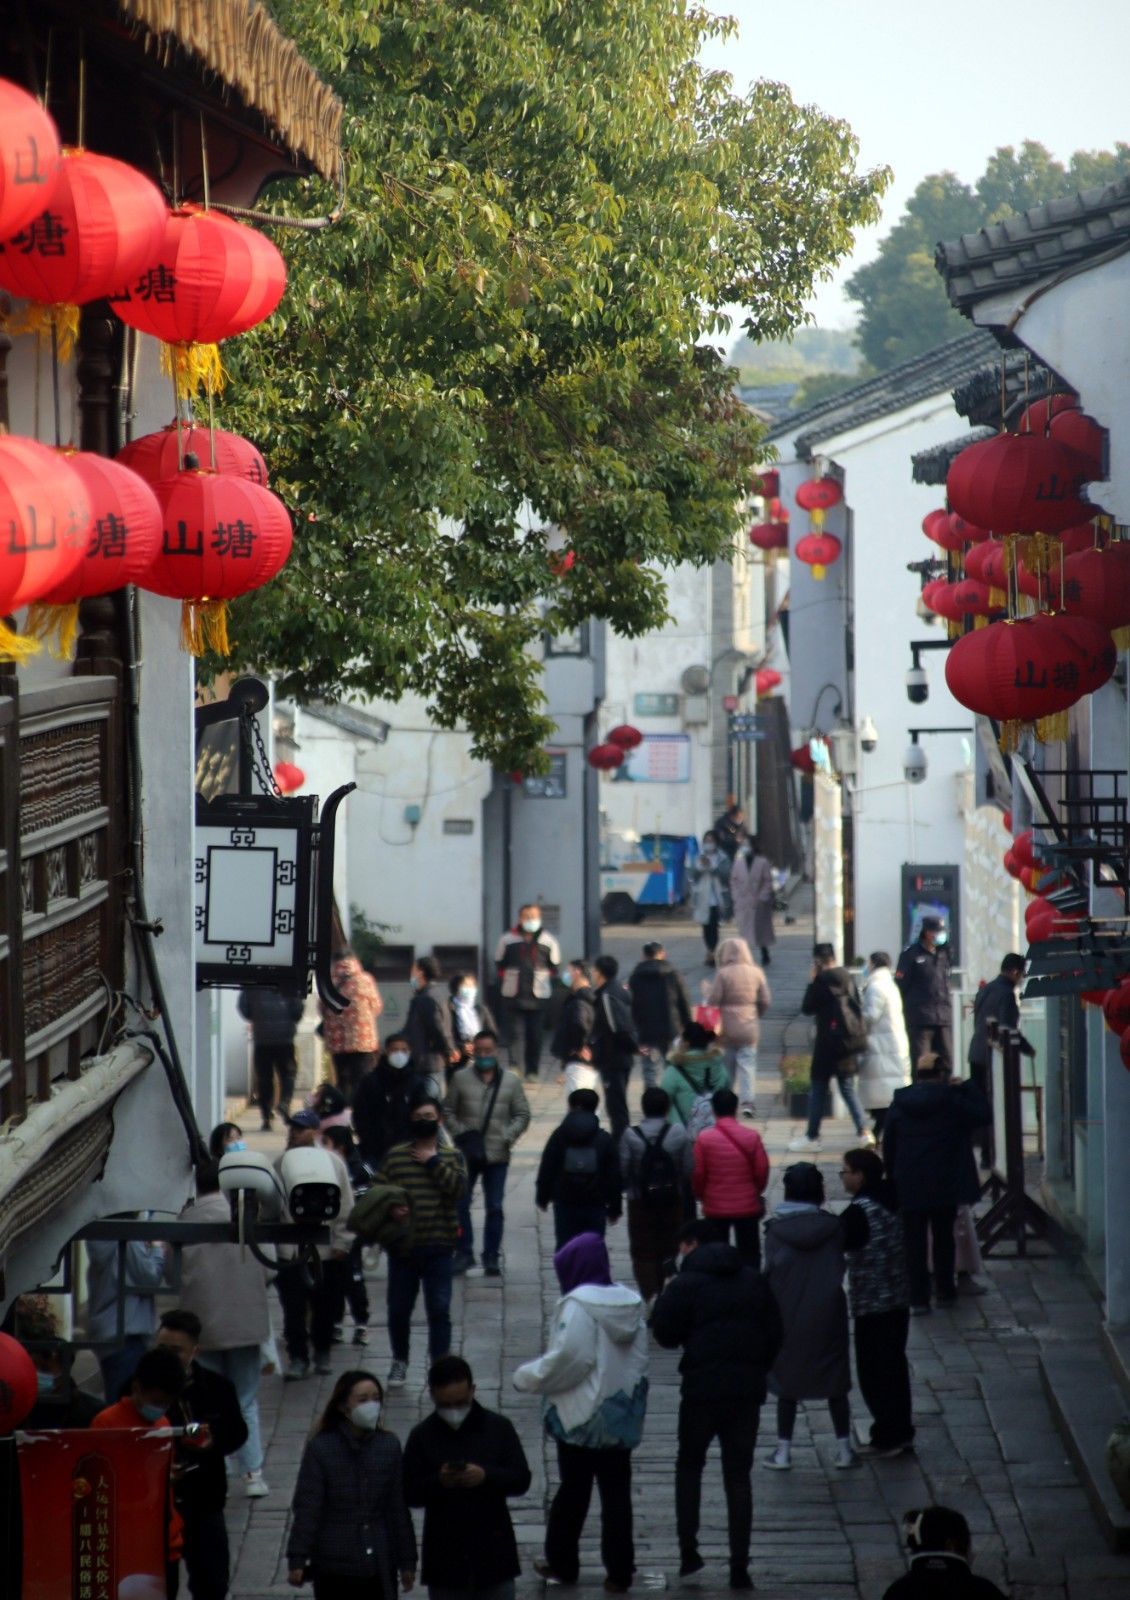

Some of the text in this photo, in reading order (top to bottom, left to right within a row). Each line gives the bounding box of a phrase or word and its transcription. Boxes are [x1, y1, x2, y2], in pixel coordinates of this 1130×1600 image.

[0, 209, 69, 257] 塘
[163, 519, 257, 559] 山塘
[1014, 658, 1080, 692] 山塘
